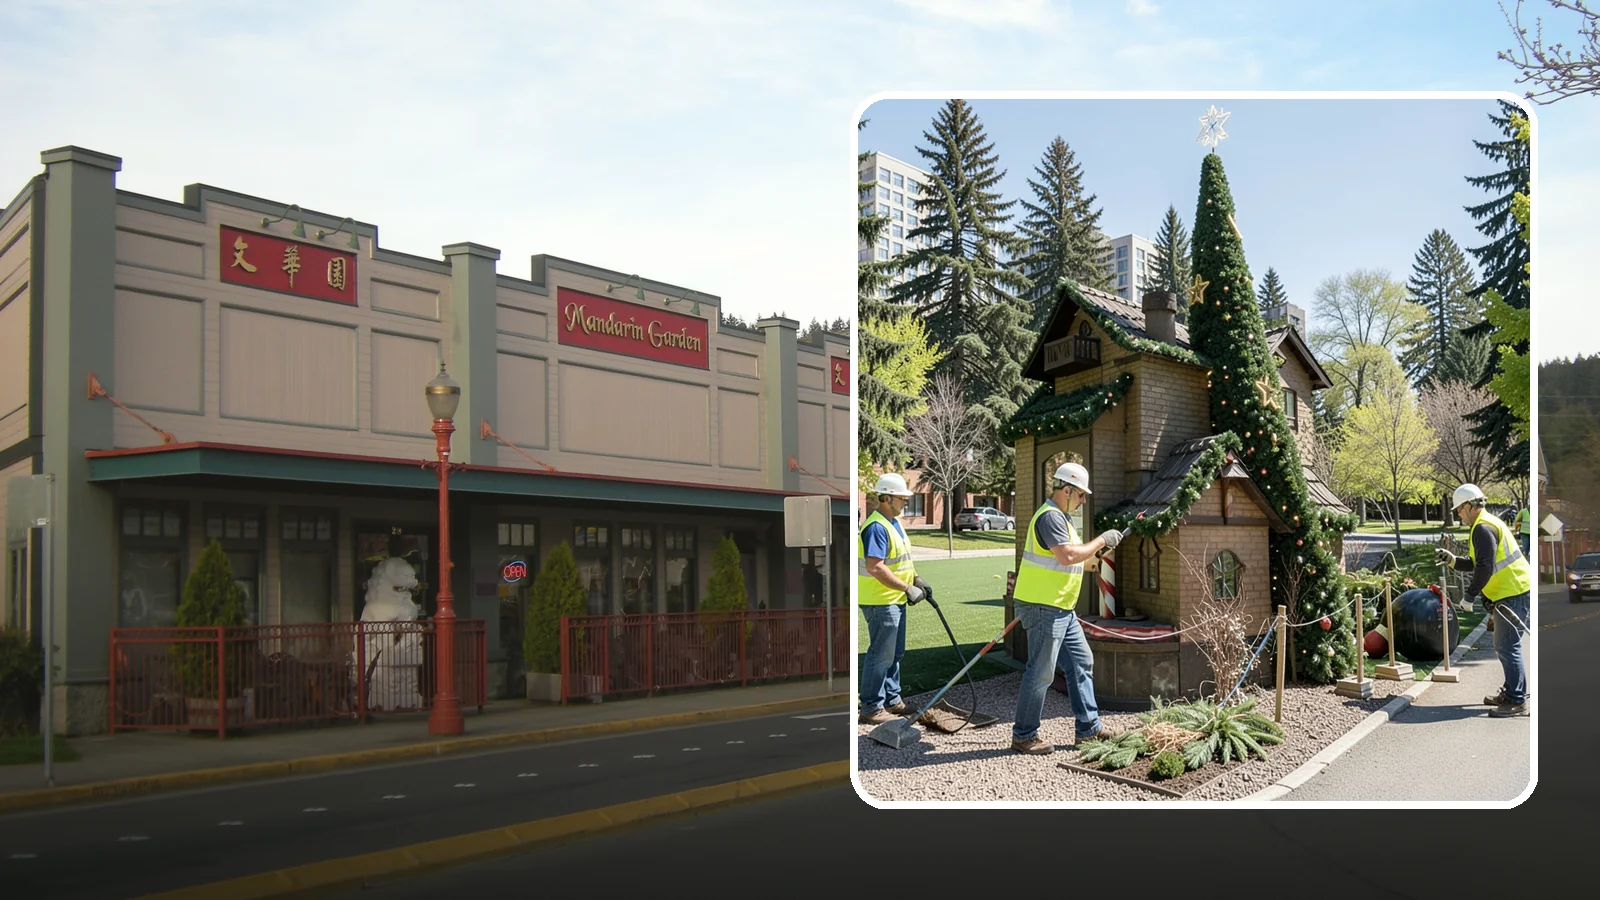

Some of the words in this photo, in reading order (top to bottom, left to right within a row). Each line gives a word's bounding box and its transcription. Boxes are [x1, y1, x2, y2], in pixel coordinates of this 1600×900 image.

[231, 236, 346, 291] 文華園
[564, 302, 644, 341] Mandarin
[647, 320, 702, 352] Garden
[503, 565, 527, 578] OPEN
